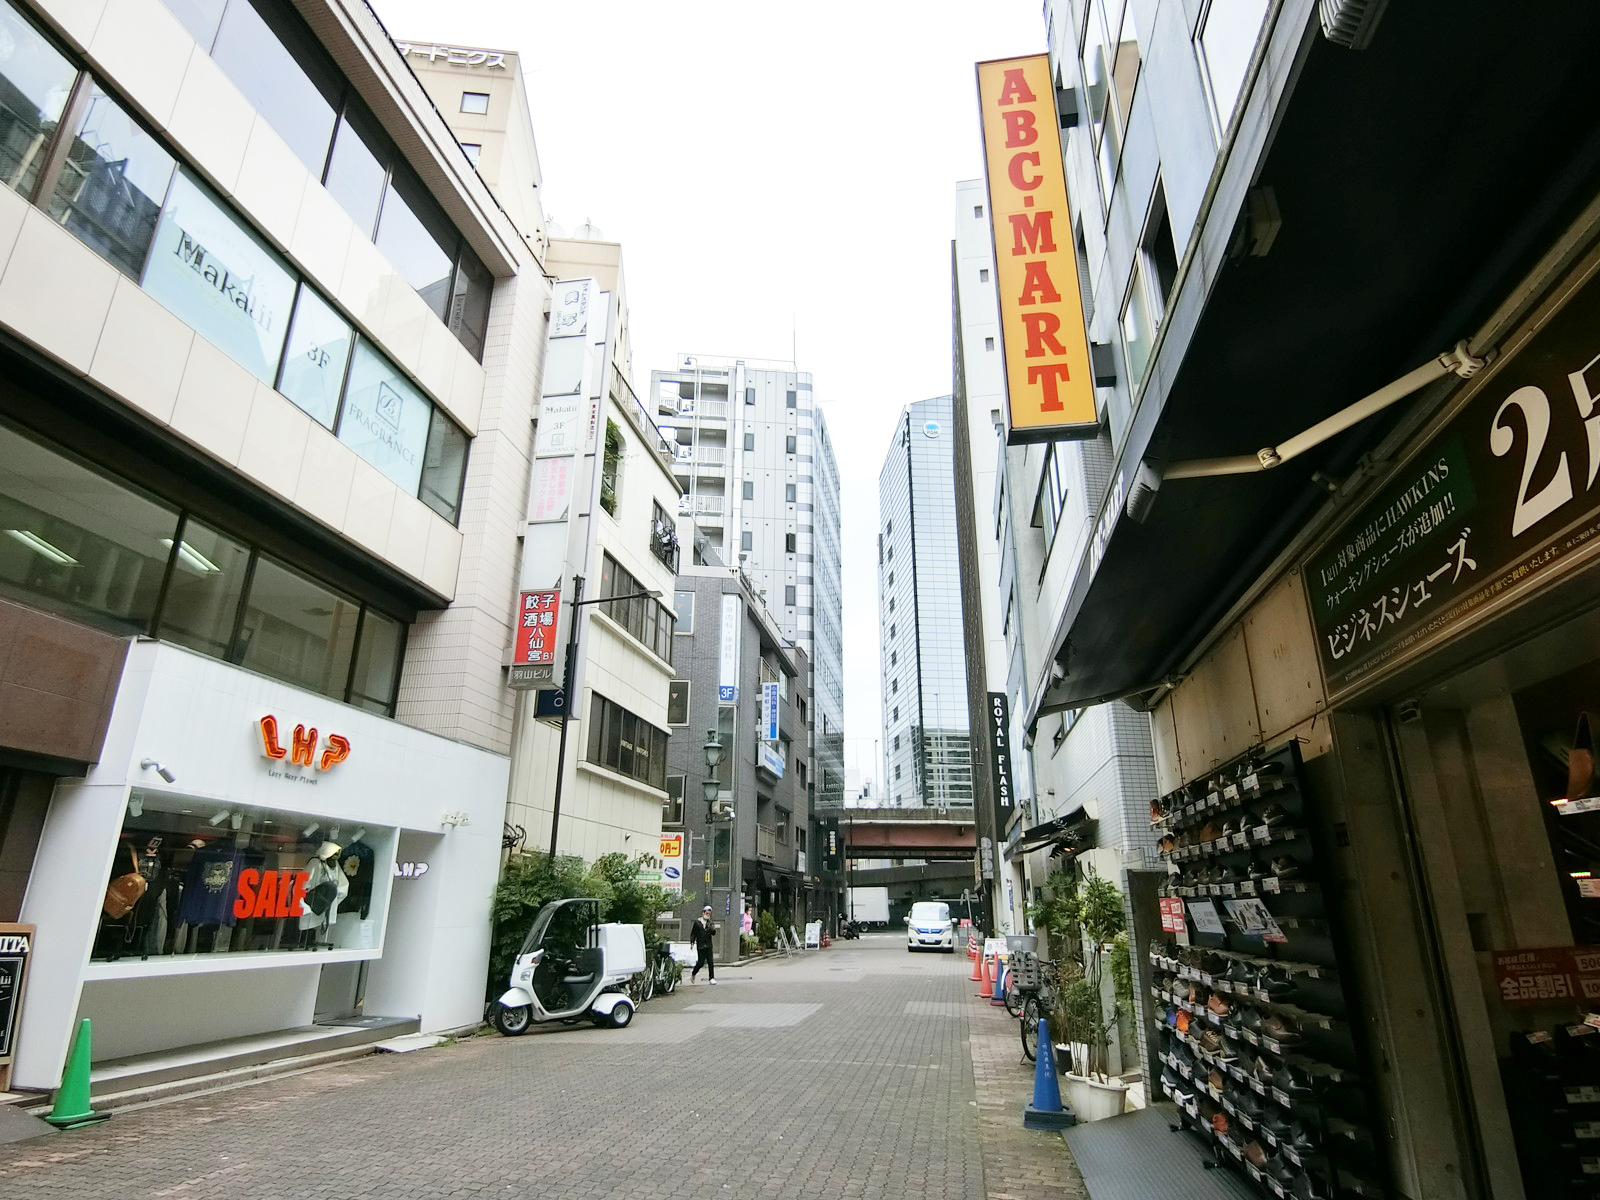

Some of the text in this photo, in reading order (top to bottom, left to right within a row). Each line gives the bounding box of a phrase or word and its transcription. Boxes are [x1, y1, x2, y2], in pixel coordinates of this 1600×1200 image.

[173, 228, 273, 332] Makalii
[307, 342, 331, 369] 3F
[545, 405, 577, 415] Makalii
[349, 403, 416, 467] FRAGRANCE
[553, 422, 565, 430] 3F
[525, 594, 555, 610] 餃子
[1328, 527, 1477, 660] ビジネスシューズ
[523, 611, 554, 627] 酒場
[527, 627, 545, 662] 八仙宮
[542, 652, 554, 661] B1
[513, 669, 552, 680] 羽山ビル
[721, 687, 733, 699] 3F
[993, 697, 1010, 807] ROYAL FLASH
[233, 868, 310, 919] SALE
[1500, 973, 1575, 1001] 全品割引
